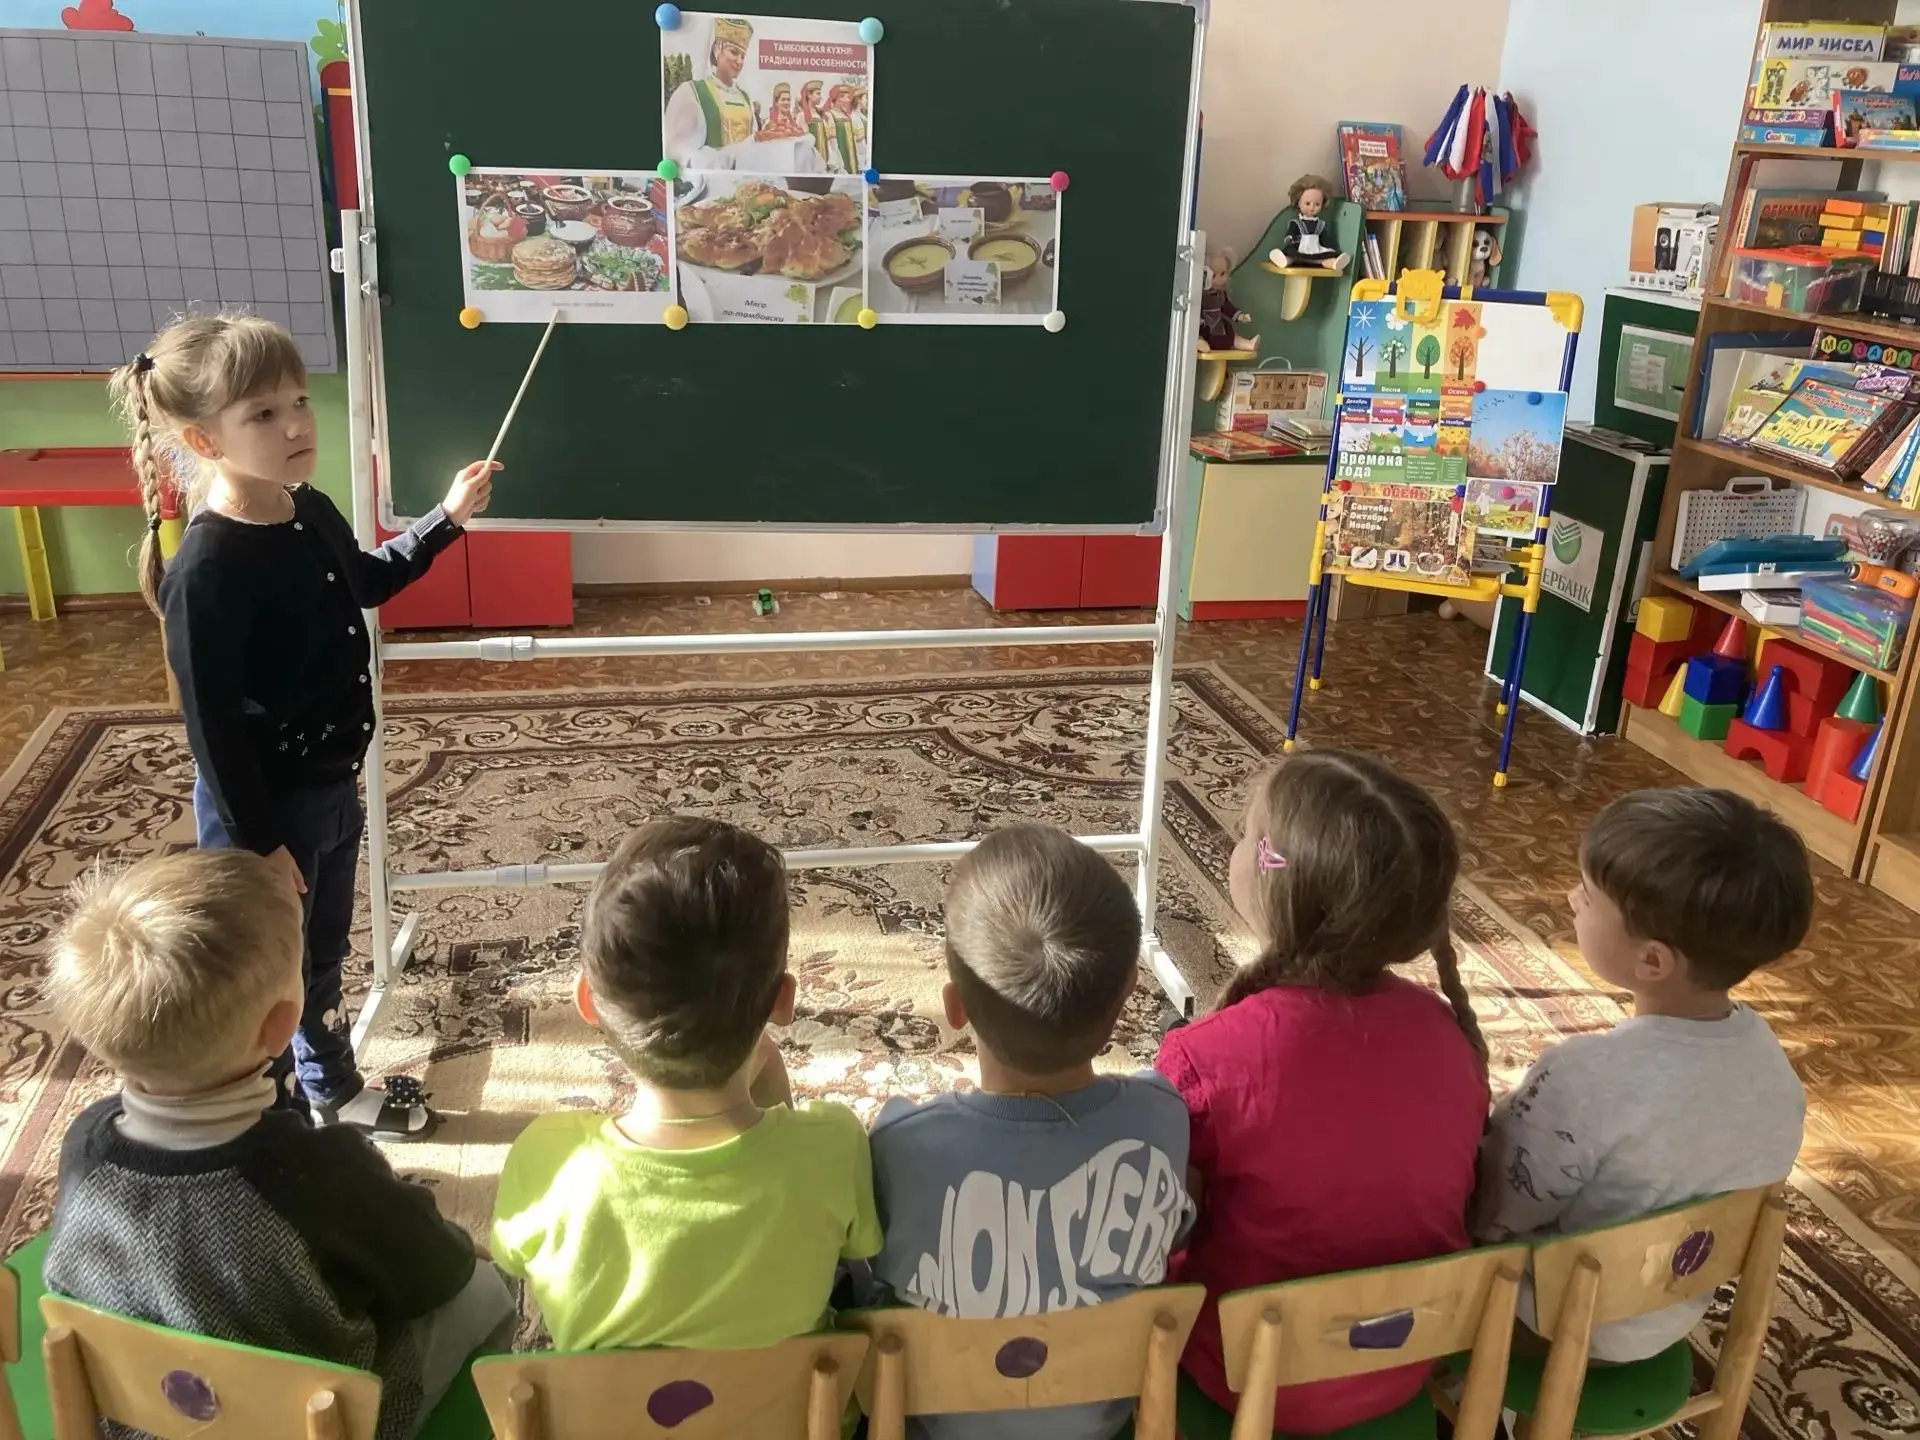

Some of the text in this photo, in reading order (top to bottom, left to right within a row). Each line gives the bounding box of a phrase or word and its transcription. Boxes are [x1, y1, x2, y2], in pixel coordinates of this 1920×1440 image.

[773, 43, 826, 54] ТАМБОВСКАЯ
[1777, 36, 1874, 53] МИР ЧИСЕЛ
[760, 55, 867, 69] ТРАДИЦИИ И ОСОБЕННОСТИ
[744, 300, 767, 309] Мясо
[721, 309, 785, 323] по-тамбовски
[1381, 385, 1401, 393] Весна
[1340, 452, 1403, 466] Времена
[1338, 465, 1372, 478] года
[1382, 486, 1428, 500] ОСЕНЬ
[1351, 502, 1394, 513] Сентябрь
[1350, 511, 1389, 522] Октябрь
[1348, 520, 1382, 531] Ноябрь
[1542, 567, 1591, 606] ЕРБАНК
